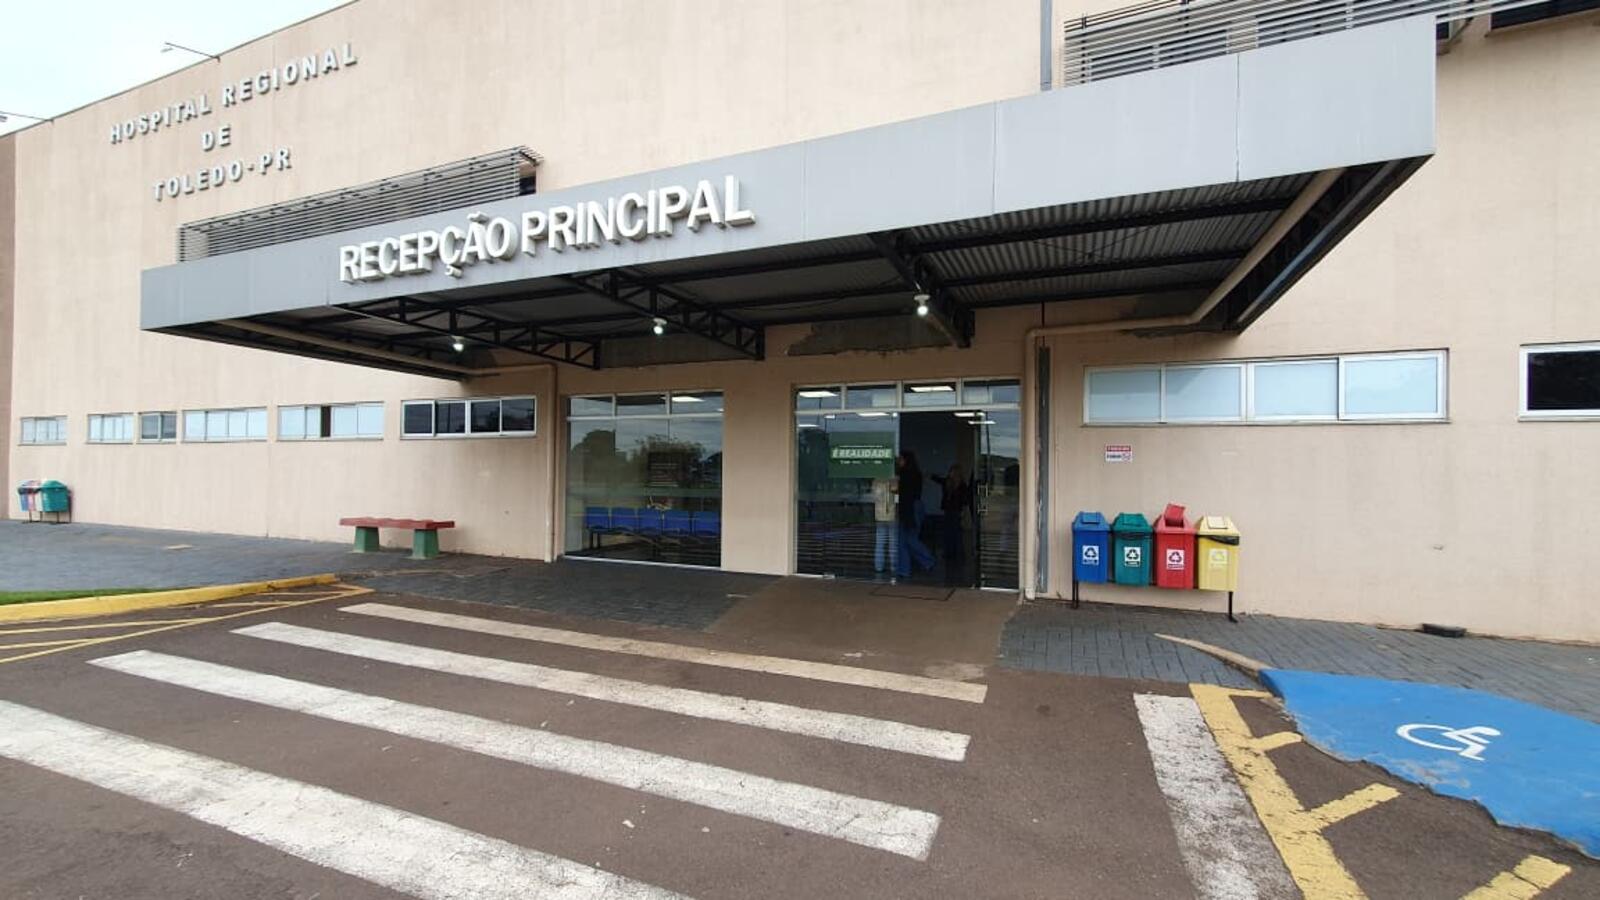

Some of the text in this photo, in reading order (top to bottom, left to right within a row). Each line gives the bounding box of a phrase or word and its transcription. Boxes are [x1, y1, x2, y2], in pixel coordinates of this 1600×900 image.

[110, 43, 359, 145] HOSPITAL REGIONAL
[201, 125, 232, 152] DE
[339, 174, 757, 286] RECEPÇÃO PRINCIPAL
[839, 448, 892, 458] REALIDADE
